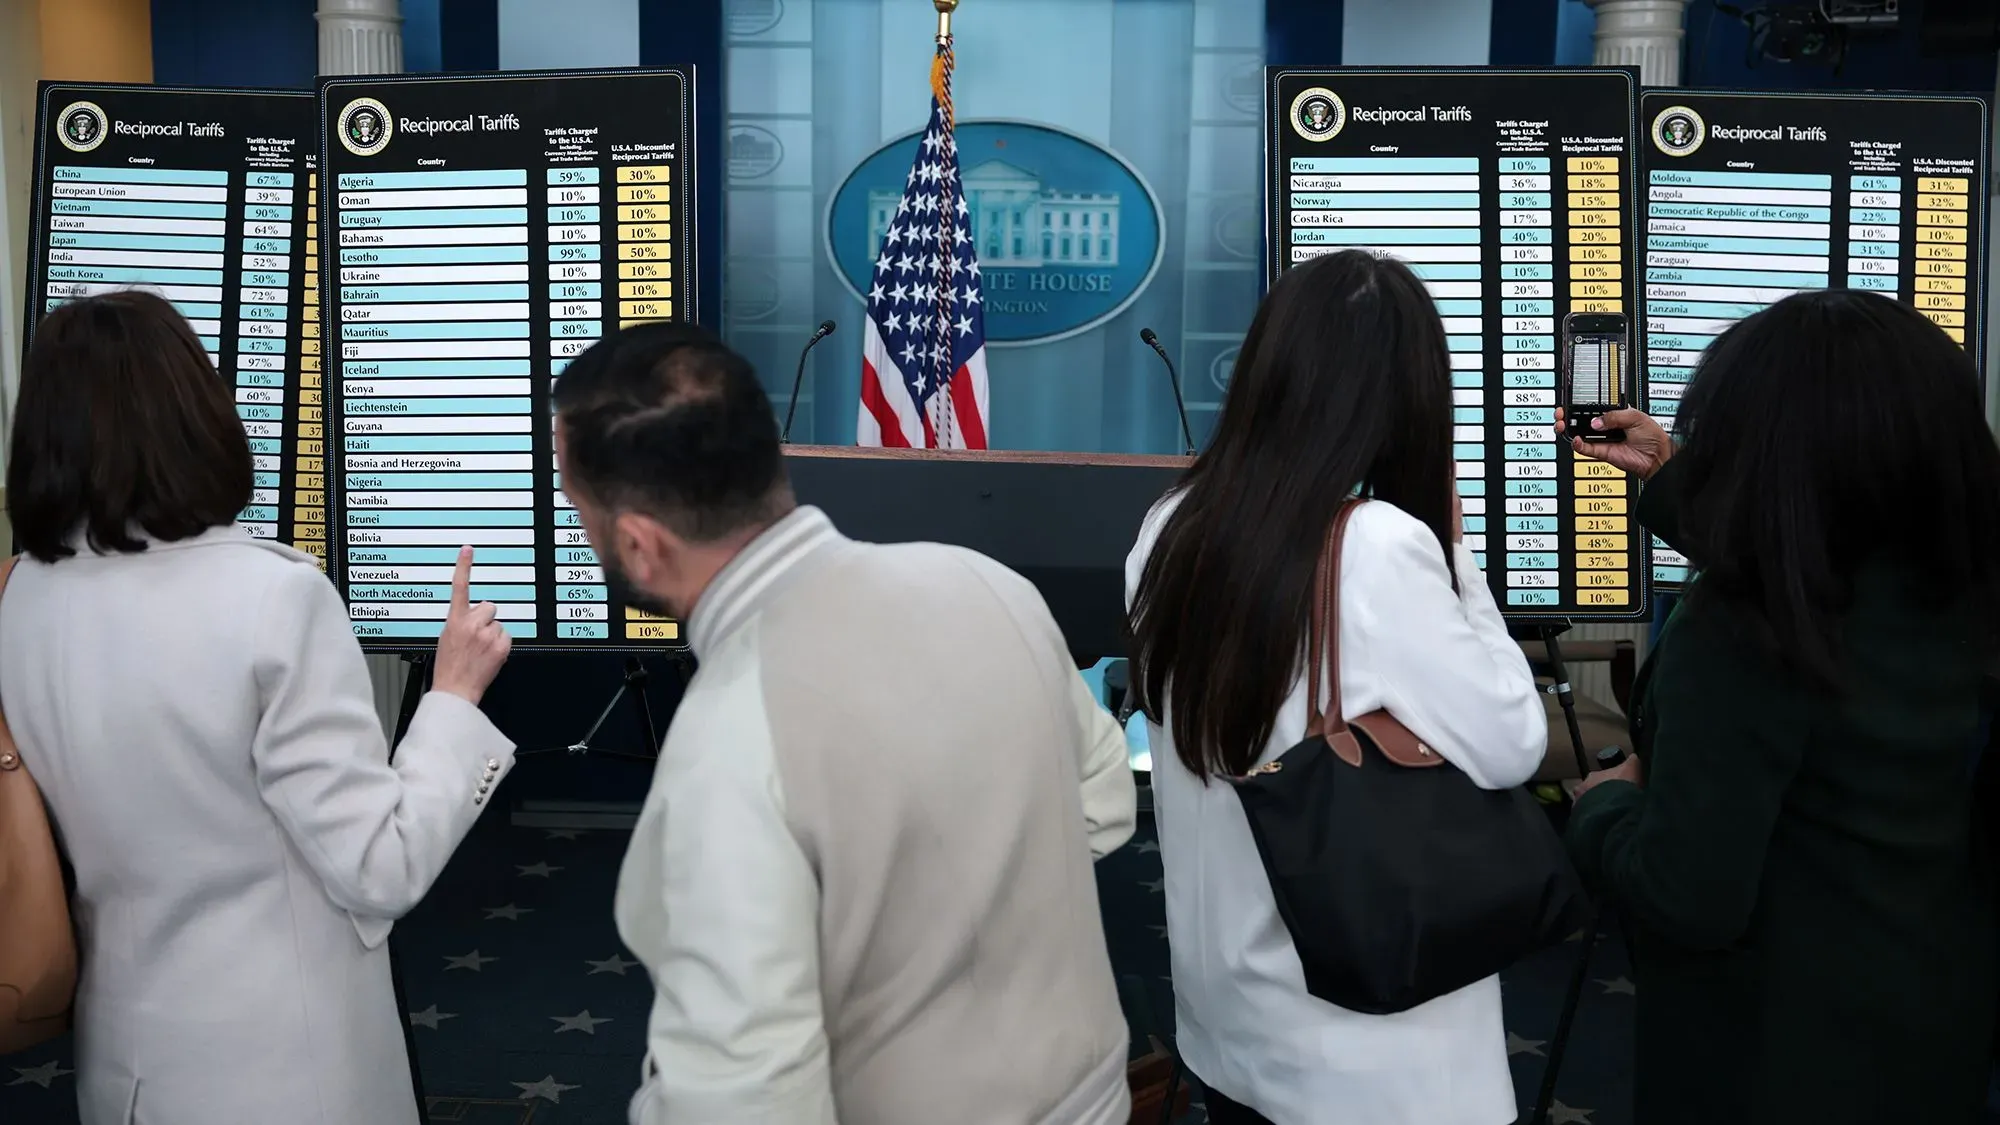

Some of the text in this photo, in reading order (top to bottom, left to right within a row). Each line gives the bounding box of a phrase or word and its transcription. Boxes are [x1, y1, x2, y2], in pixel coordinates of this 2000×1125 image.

[1353, 105, 1472, 126] Reciprocal Tariffs
[115, 120, 225, 139] Reciprocal Tariffs
[400, 113, 520, 137] Reciprocal Tariffs
[1519, 120, 1549, 129] Charged
[570, 127, 598, 136] Charged
[1712, 125, 1827, 143] Reciprocal Tariffs
[267, 138, 295, 146] Charged
[571, 136, 593, 144] U.S.A.
[611, 143, 675, 152] U.S.A. Discounted
[1370, 145, 1399, 153] Country
[1562, 144, 1623, 153] Reciprocal Tariffs
[1874, 141, 1901, 150] Charged
[128, 156, 155, 165] Country
[417, 158, 446, 167] Country
[611, 152, 674, 163] Reciprocal Tariffs
[1935, 158, 1974, 166] Discounted
[1292, 161, 1315, 171] Peru
[1726, 160, 1755, 169] Country
[55, 169, 81, 179] China
[1913, 166, 1950, 174] Reciprocal
[257, 176, 281, 185] 67%
[559, 172, 585, 182] 59%
[629, 170, 656, 181] 30%
[1651, 173, 1692, 183] Moldova
[340, 176, 374, 189] Algeria
[1292, 178, 1342, 190] Nicaragua
[1512, 179, 1536, 188] 36%
[1862, 180, 1887, 190] 61%
[54, 186, 126, 196] European Union
[1650, 189, 1683, 200] Angola
[341, 196, 370, 205] Oman
[1293, 196, 1331, 208] Norway
[1512, 197, 1537, 206] 30%
[1582, 197, 1606, 206] 15%
[1862, 196, 1887, 205] 63%
[1929, 198, 1954, 206] 32%
[53, 203, 91, 212] Vietnam
[255, 209, 279, 218] 90%
[631, 208, 656, 219] 10%
[1650, 206, 1809, 220] Democratic Republic of the Congo
[53, 219, 84, 228] Taiwan
[341, 215, 381, 226] Uruguay
[1293, 214, 1343, 223] Costa Rica
[1928, 215, 1953, 225] 11%
[255, 225, 278, 235] 64%
[1649, 222, 1686, 232] Jamaica
[51, 236, 77, 245] Japan
[342, 233, 384, 243] Bahamas
[1293, 232, 1325, 243] Jordan
[1513, 232, 1538, 241] 40%
[1581, 232, 1607, 241] 20%
[1649, 239, 1709, 250] Mozambique
[560, 248, 586, 259] 99%
[631, 247, 657, 258] 50%
[1514, 249, 1538, 259] 10%
[1860, 246, 1885, 255] 31%
[51, 252, 73, 261] India
[342, 252, 378, 262] Lesotho
[1648, 255, 1691, 266] Paraguay
[253, 258, 277, 267] 52%
[49, 270, 103, 278] South Korea
[1927, 264, 1953, 274] 10%
[252, 274, 276, 284] 50%
[342, 271, 380, 281] Ukraine
[1648, 271, 1682, 280] Zambia
[1030, 272, 1113, 292] HOUSE
[1859, 278, 1884, 289] 33%
[1928, 281, 1952, 289] 17%
[49, 286, 87, 295] Thailand
[343, 290, 379, 299] Bahrain
[563, 286, 587, 296] 10%
[1647, 288, 1687, 297] Lebanon
[982, 301, 1048, 313] INGTON
[1515, 303, 1540, 313] 10%
[251, 308, 274, 317] 61%
[343, 309, 371, 320] Qatar
[250, 325, 274, 334] 64%
[562, 324, 588, 334] 80%
[1516, 321, 1540, 331] 12%
[344, 327, 388, 337] Mauritius
[249, 341, 273, 351] 47%
[344, 346, 359, 358] Fiji
[248, 358, 272, 367] 97%
[344, 364, 380, 376] Iceland
[249, 375, 271, 384] 10%
[1515, 375, 1541, 385] 93%
[345, 383, 374, 396] Kenya
[246, 392, 270, 401] 60%
[346, 402, 407, 412] Liechtenstein
[1516, 411, 1542, 421] 55%
[346, 421, 383, 433] Guyana
[1517, 429, 1542, 439] 54%
[347, 440, 370, 449] Haiti
[347, 458, 462, 470] Bosnia and Herzegovina
[347, 476, 383, 489] Nigeria
[1519, 484, 1543, 493] 10%
[348, 495, 388, 506] Namibia
[349, 514, 379, 524] Brunei
[1518, 520, 1544, 530] 41%
[1588, 520, 1613, 530] 21%
[349, 532, 382, 543] Bolivia
[566, 532, 591, 544] 20%
[1588, 538, 1614, 548] 48%
[350, 552, 387, 561] Panama
[1519, 557, 1544, 566] 74%
[350, 570, 400, 580] Venezuela
[568, 570, 593, 580] 29%
[1521, 575, 1545, 585] 12%
[351, 588, 433, 598] North Macedonia
[568, 589, 594, 599] 65%
[1519, 593, 1545, 603] 10%
[351, 606, 390, 619] Ethiopia
[570, 607, 594, 617] 10%
[353, 625, 383, 635] Ghana
[570, 626, 594, 636] 17%
